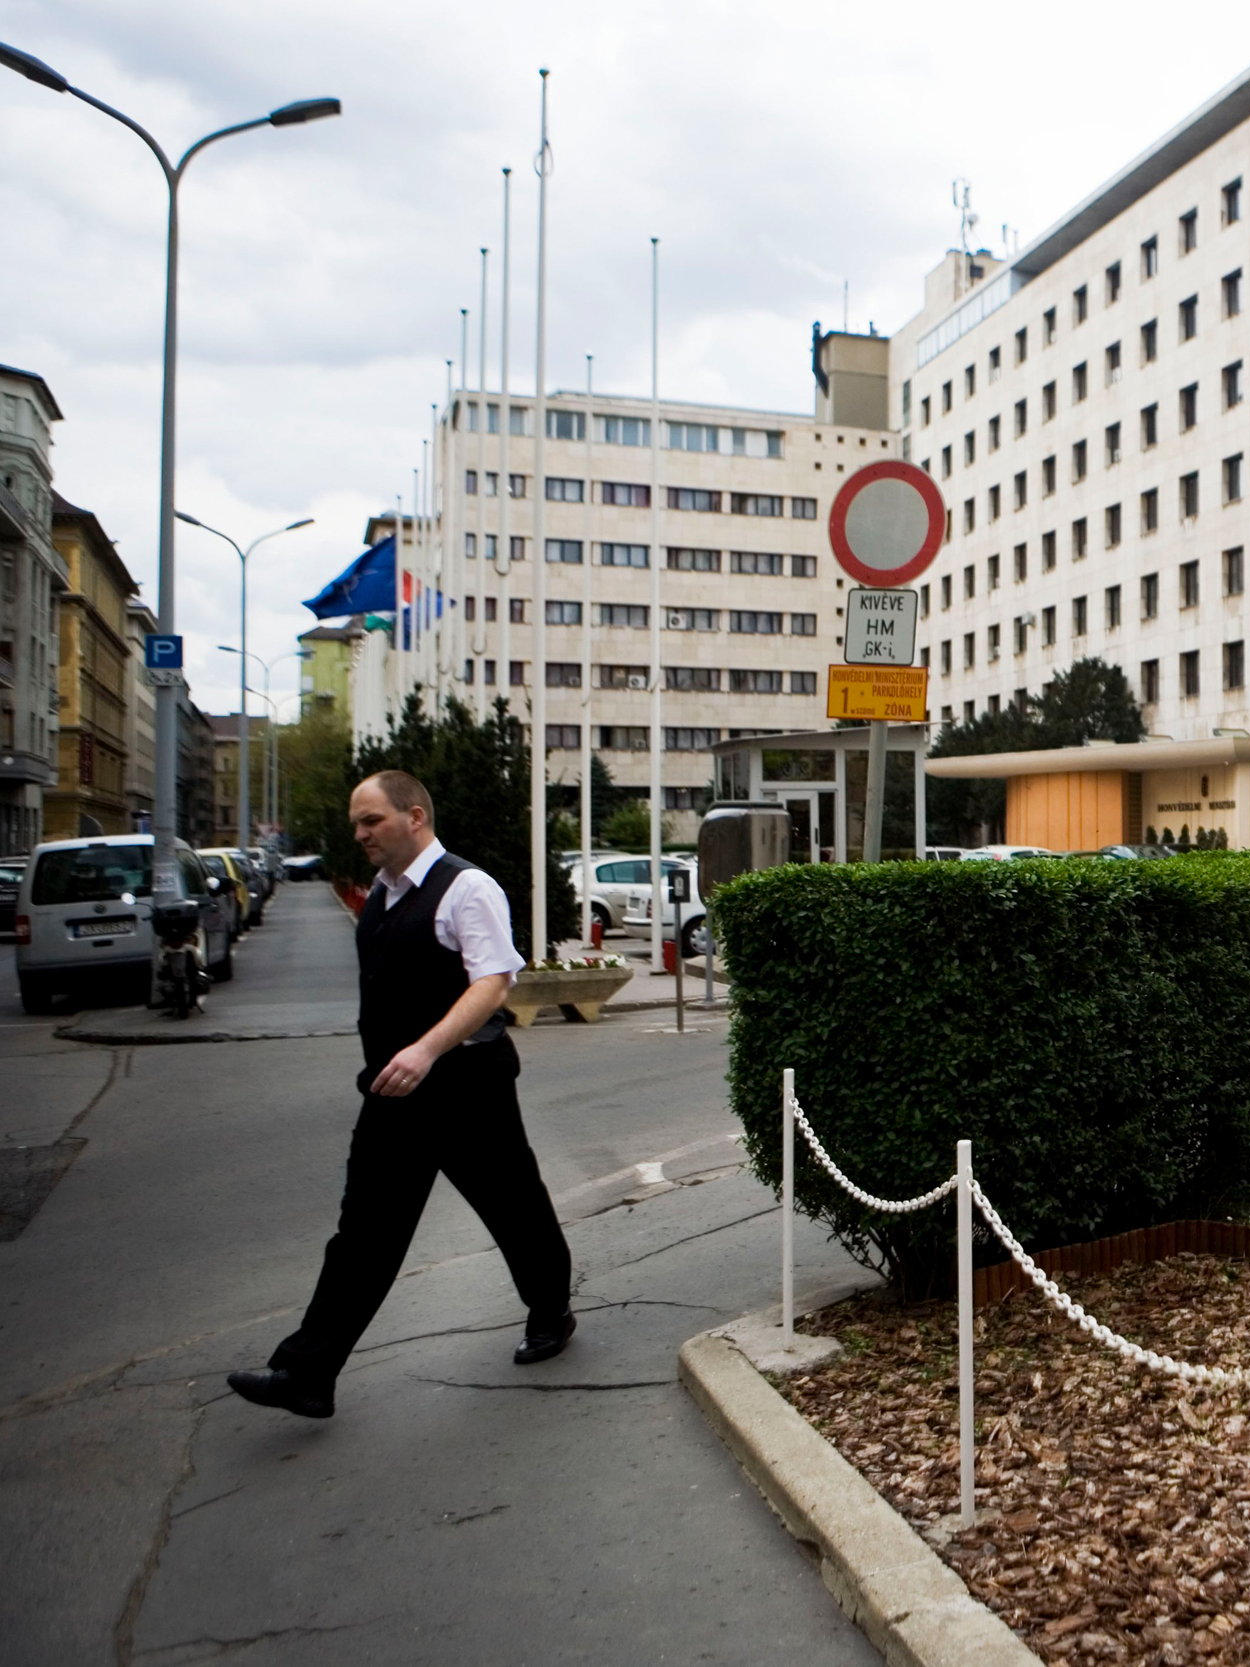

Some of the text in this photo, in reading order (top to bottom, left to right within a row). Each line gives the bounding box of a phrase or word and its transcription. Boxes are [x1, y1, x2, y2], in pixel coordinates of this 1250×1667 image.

[866, 619, 895, 636] HM
[152, 640, 176, 663] P
[832, 669, 924, 685] HONVÉDELMI MINISZTÉRIUM
[872, 684, 923, 699] PARKOLÓHELY
[884, 702, 912, 716] ZÓNA
